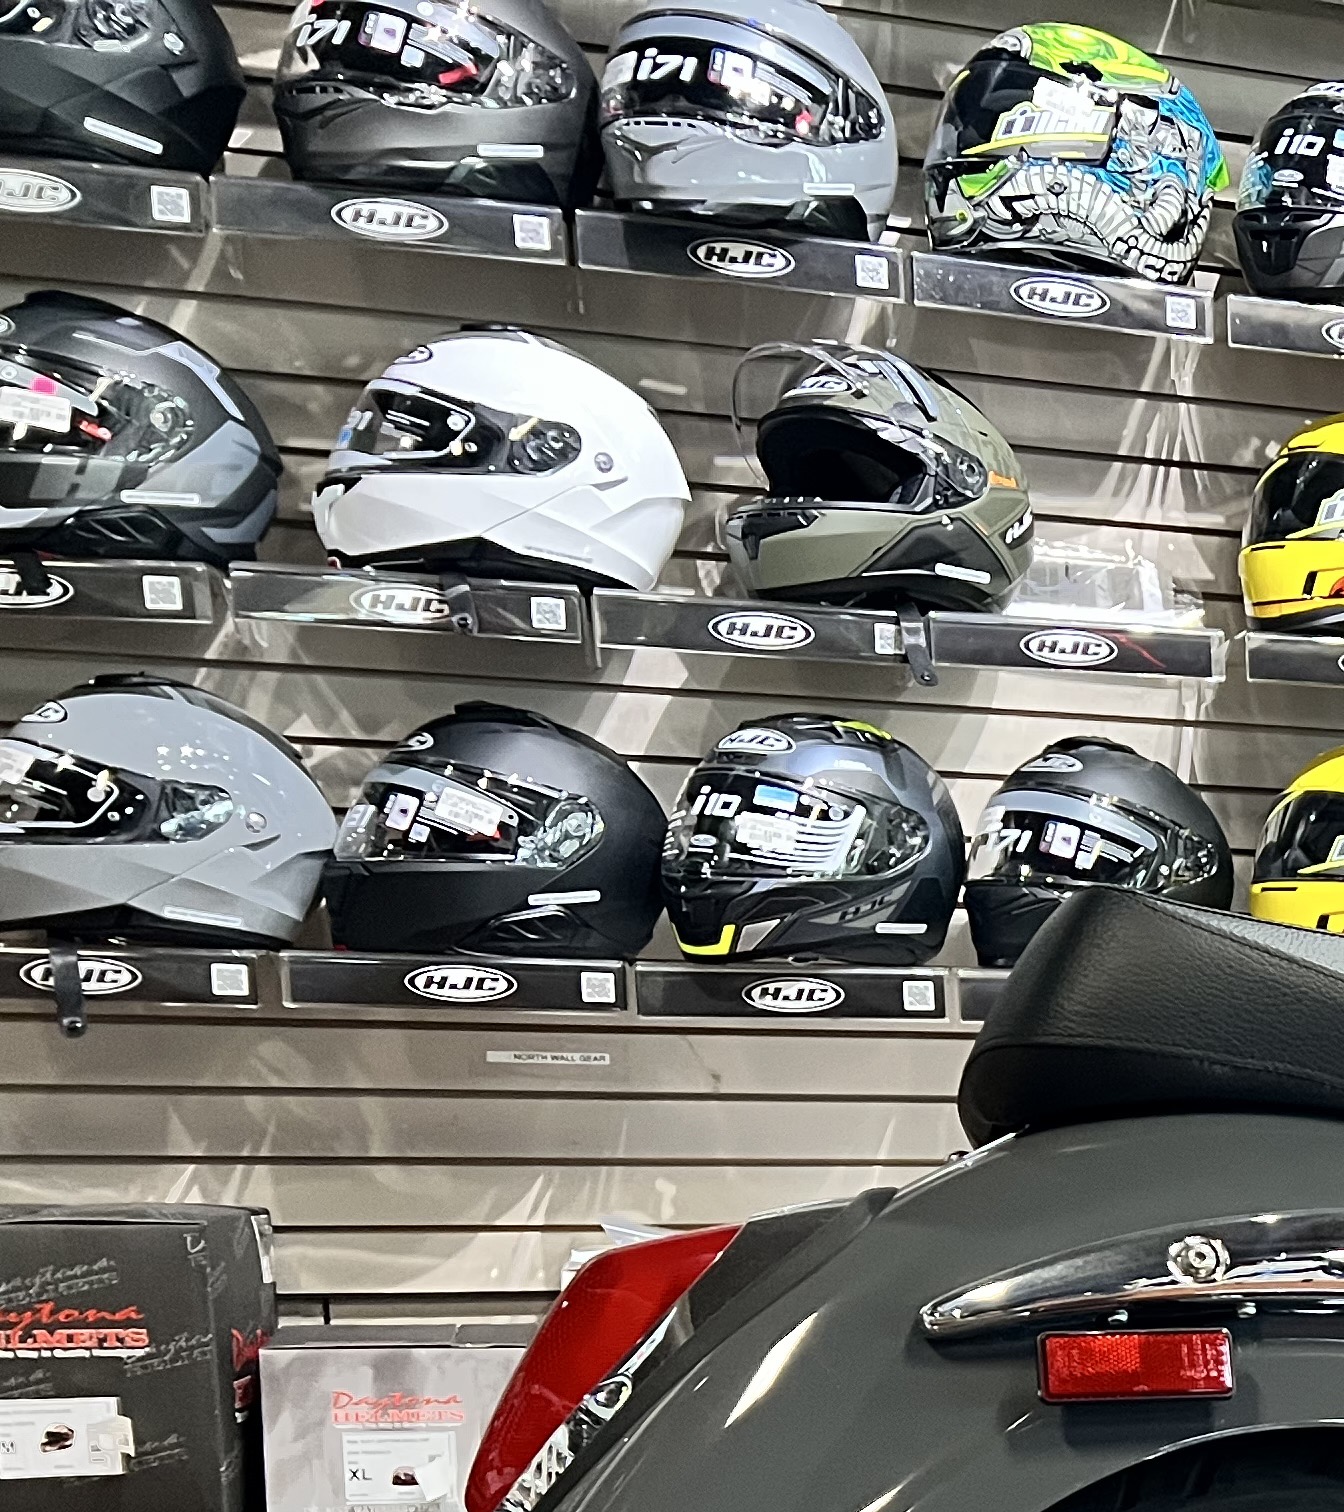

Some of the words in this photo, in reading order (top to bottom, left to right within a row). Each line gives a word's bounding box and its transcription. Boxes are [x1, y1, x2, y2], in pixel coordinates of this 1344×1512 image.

[0, 178, 60, 202] JC
[351, 208, 430, 230] HJC
[704, 245, 777, 268] HJC
[1027, 286, 1095, 308] HJC
[727, 620, 799, 640] HJC
[1036, 639, 1105, 657] HJC
[423, 975, 500, 991] HJC
[759, 986, 830, 1001] HJC
[513, 1053, 548, 1061] NORTH
[550, 1054, 576, 1062] WALL
[332, 1391, 463, 1417] Daytona
[333, 1409, 465, 1424] HELMETS
[349, 1469, 372, 1481] XL
